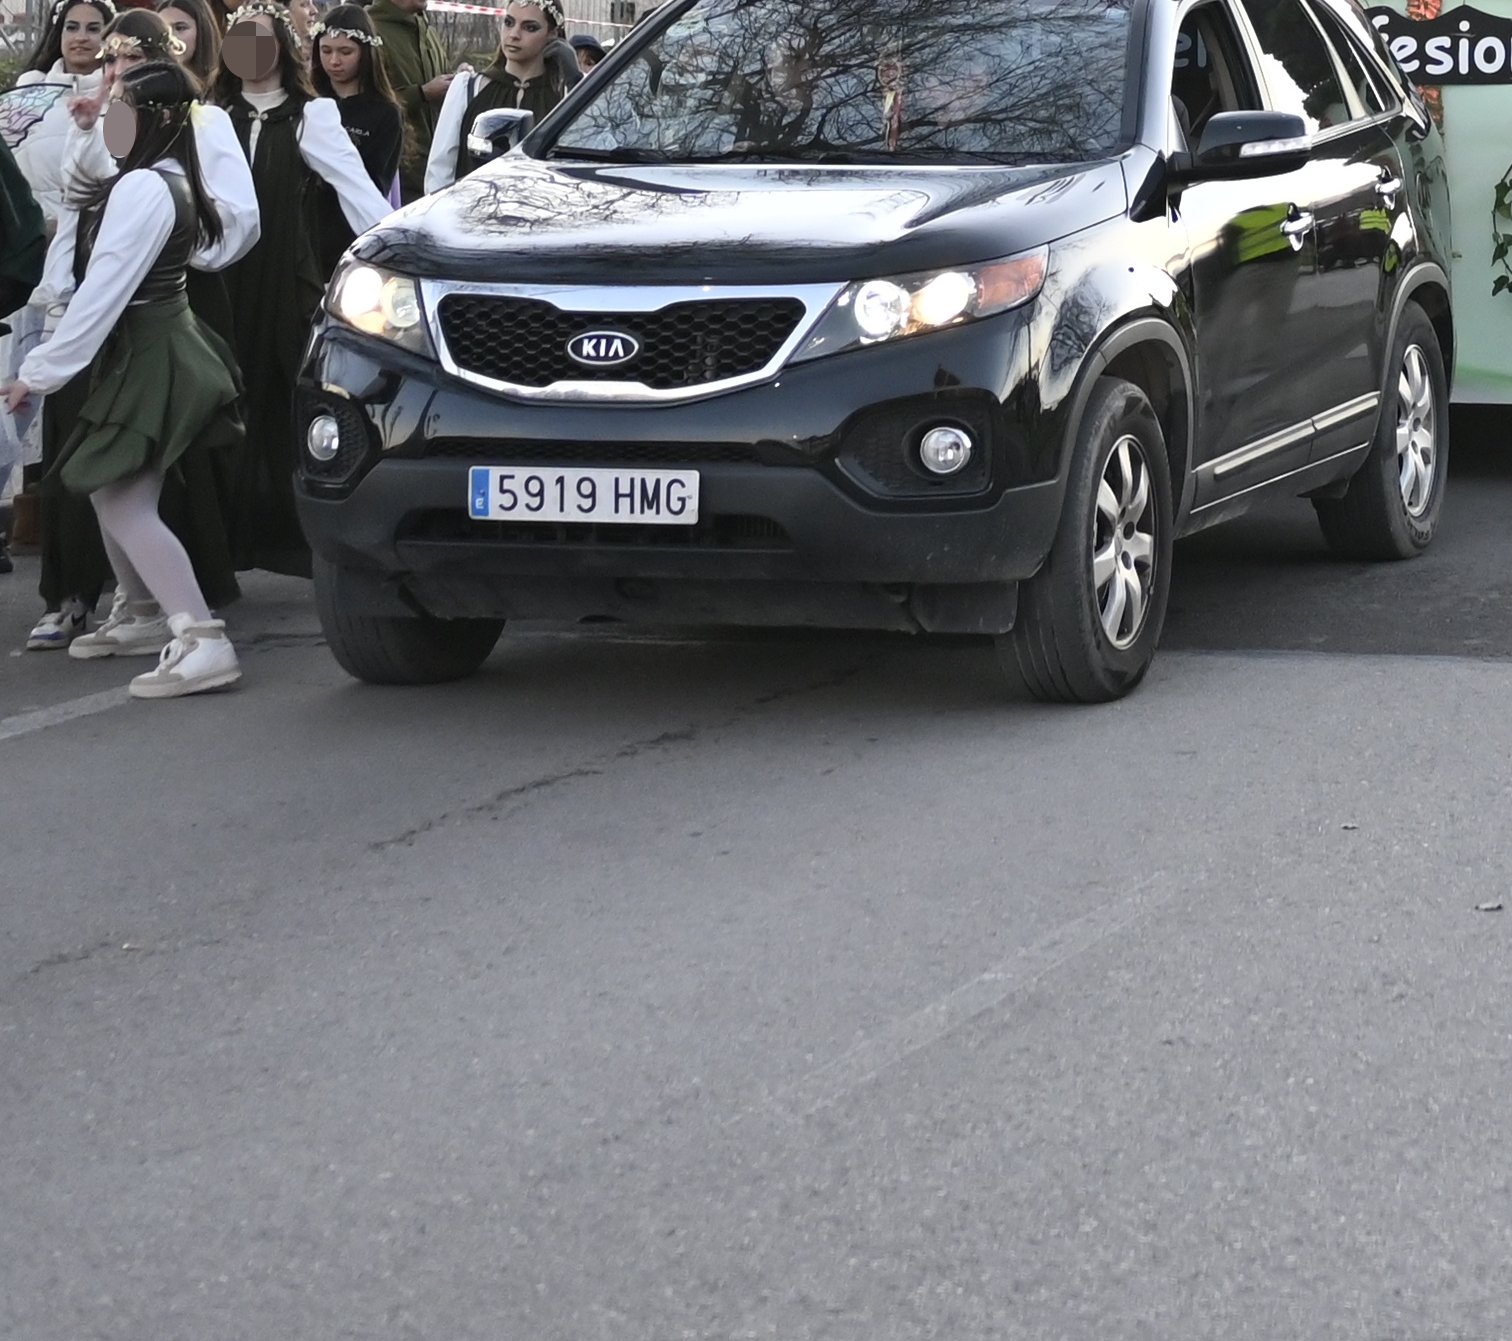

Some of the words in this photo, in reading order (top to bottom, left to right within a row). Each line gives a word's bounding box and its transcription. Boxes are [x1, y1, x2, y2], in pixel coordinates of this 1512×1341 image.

[582, 338, 624, 357] KIA
[498, 474, 597, 513] 5919
[614, 477, 686, 515] HMG
